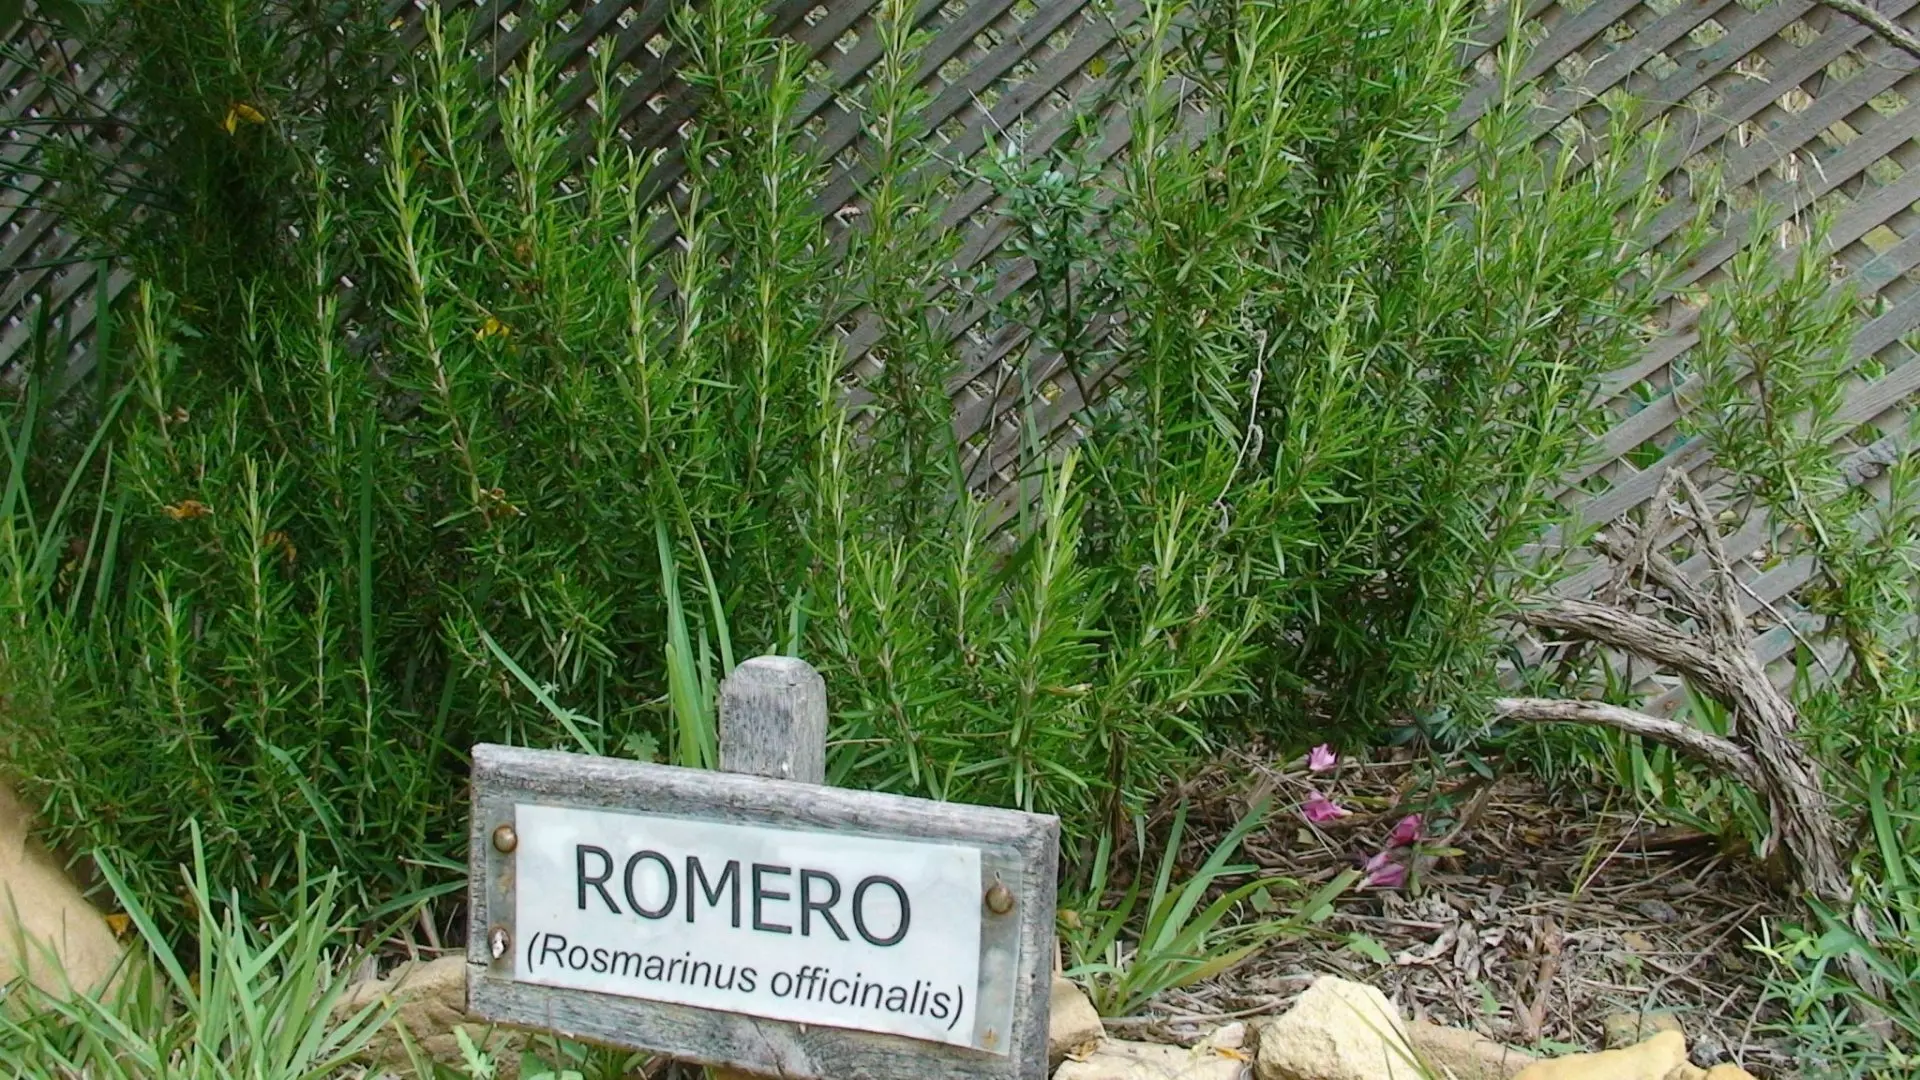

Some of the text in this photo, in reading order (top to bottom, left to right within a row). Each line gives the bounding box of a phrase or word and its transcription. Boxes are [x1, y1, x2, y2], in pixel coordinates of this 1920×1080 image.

[576, 843, 912, 947] ROMERO
[526, 931, 965, 1030] (Rosmarinus officinalis)
